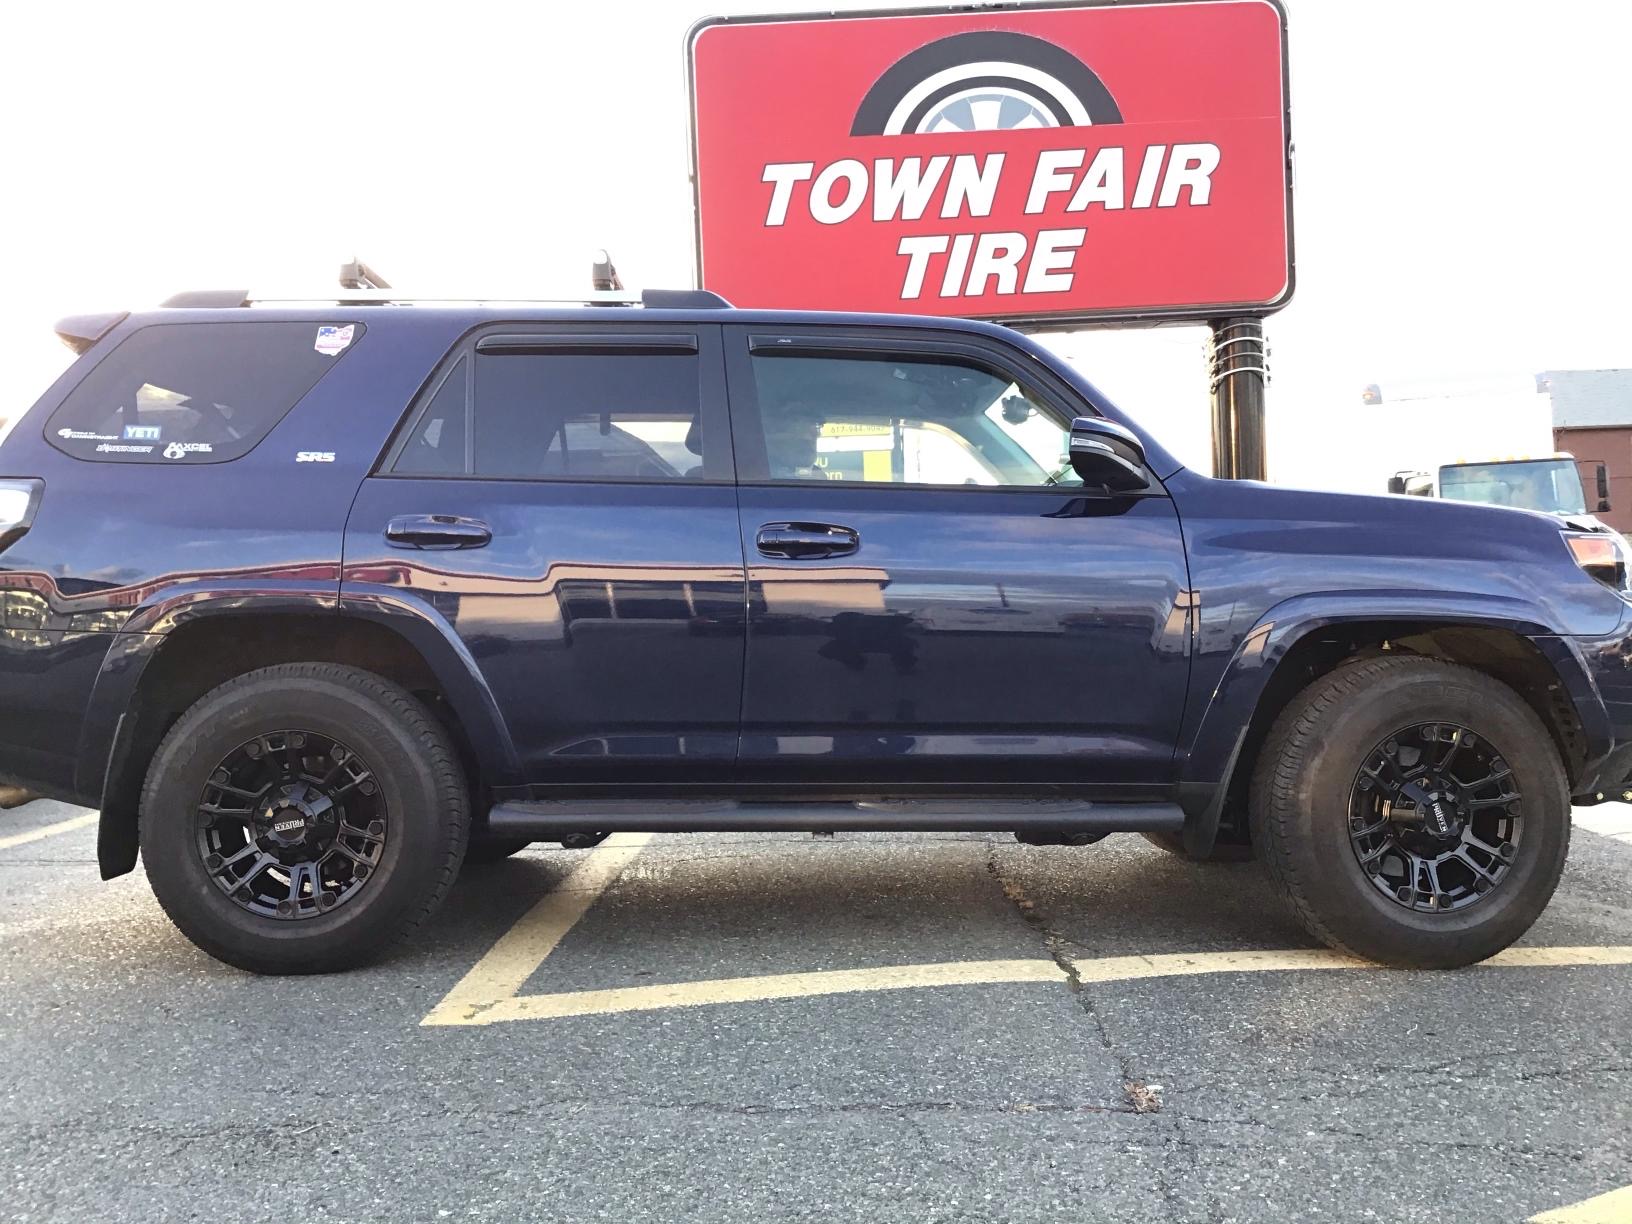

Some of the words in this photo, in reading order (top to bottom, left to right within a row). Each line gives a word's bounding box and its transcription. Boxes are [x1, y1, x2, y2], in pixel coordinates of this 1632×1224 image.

[761, 153, 1006, 227] TOWN
[1023, 142, 1221, 216] FAIR
[896, 227, 1088, 300] TIRE
[126, 426, 159, 438] YETI
[296, 451, 336, 462] SR5
